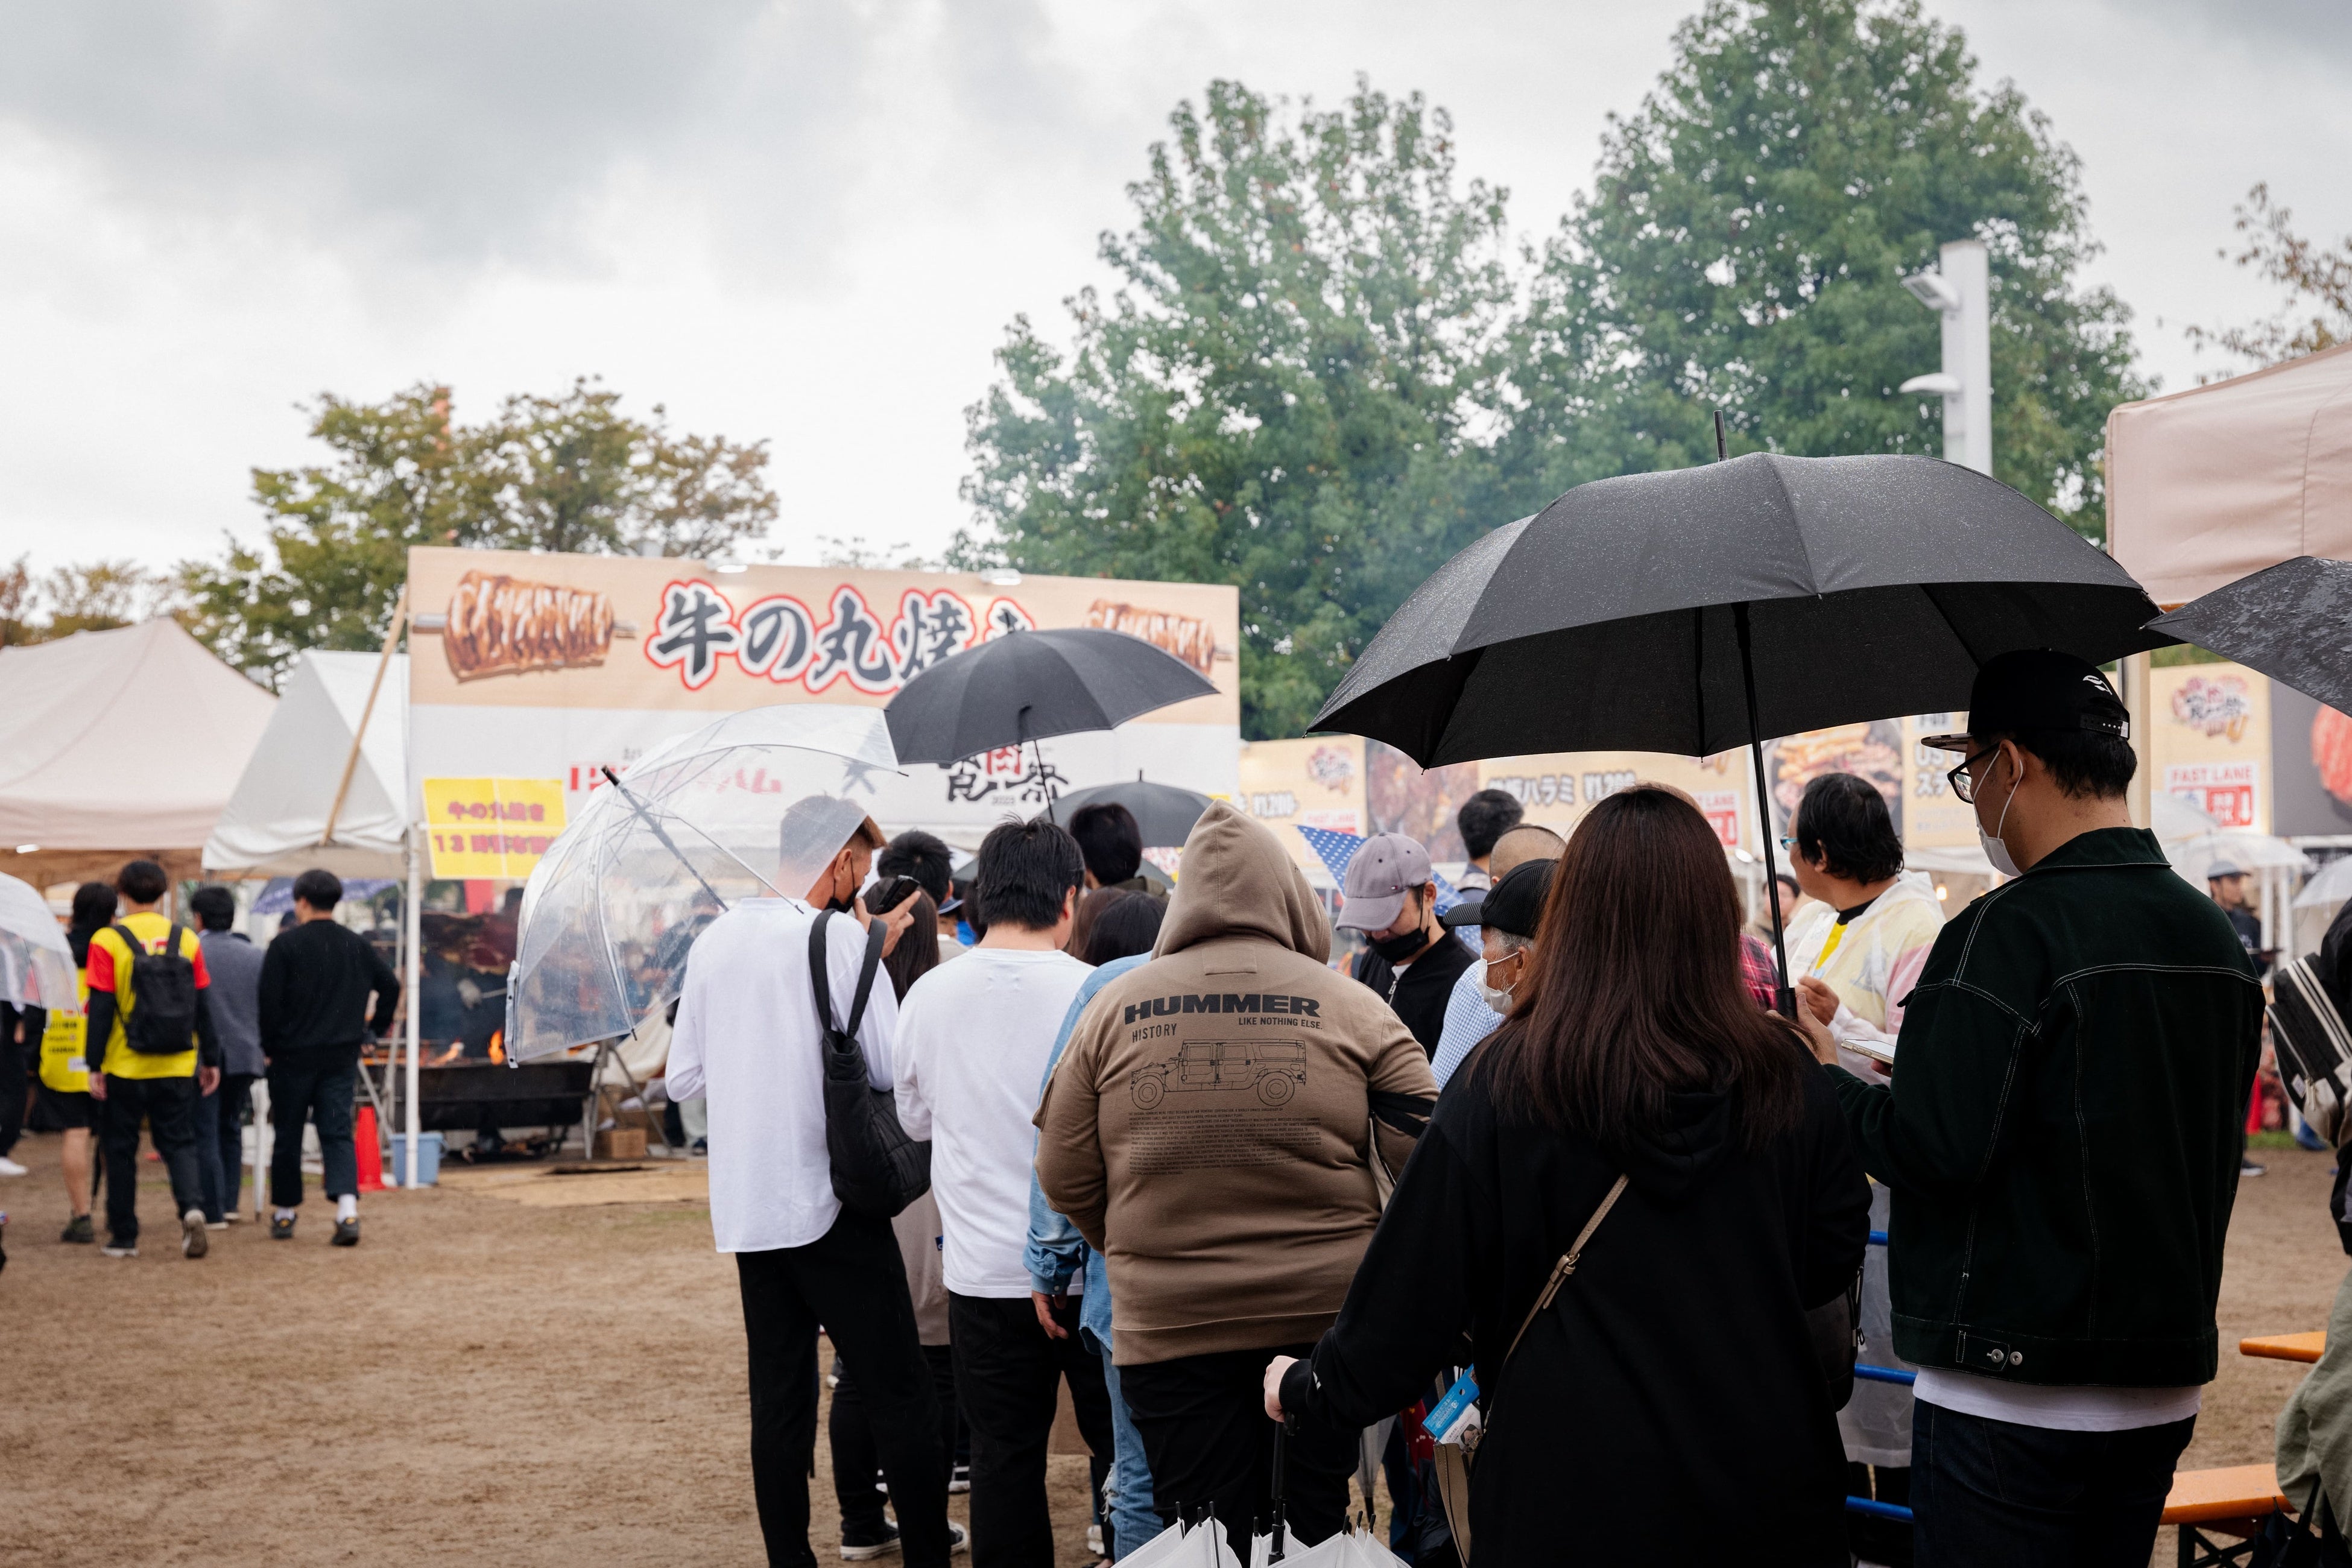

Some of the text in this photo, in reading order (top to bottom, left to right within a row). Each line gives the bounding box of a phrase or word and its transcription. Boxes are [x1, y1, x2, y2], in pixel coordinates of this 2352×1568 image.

[2172, 767, 2251, 782] FAST LANE
[1125, 994, 1321, 1025] HUMMER
[1238, 1017, 1323, 1030] LIKE NOTHING ELSE.
[1132, 1023, 1177, 1043] HISTORY
